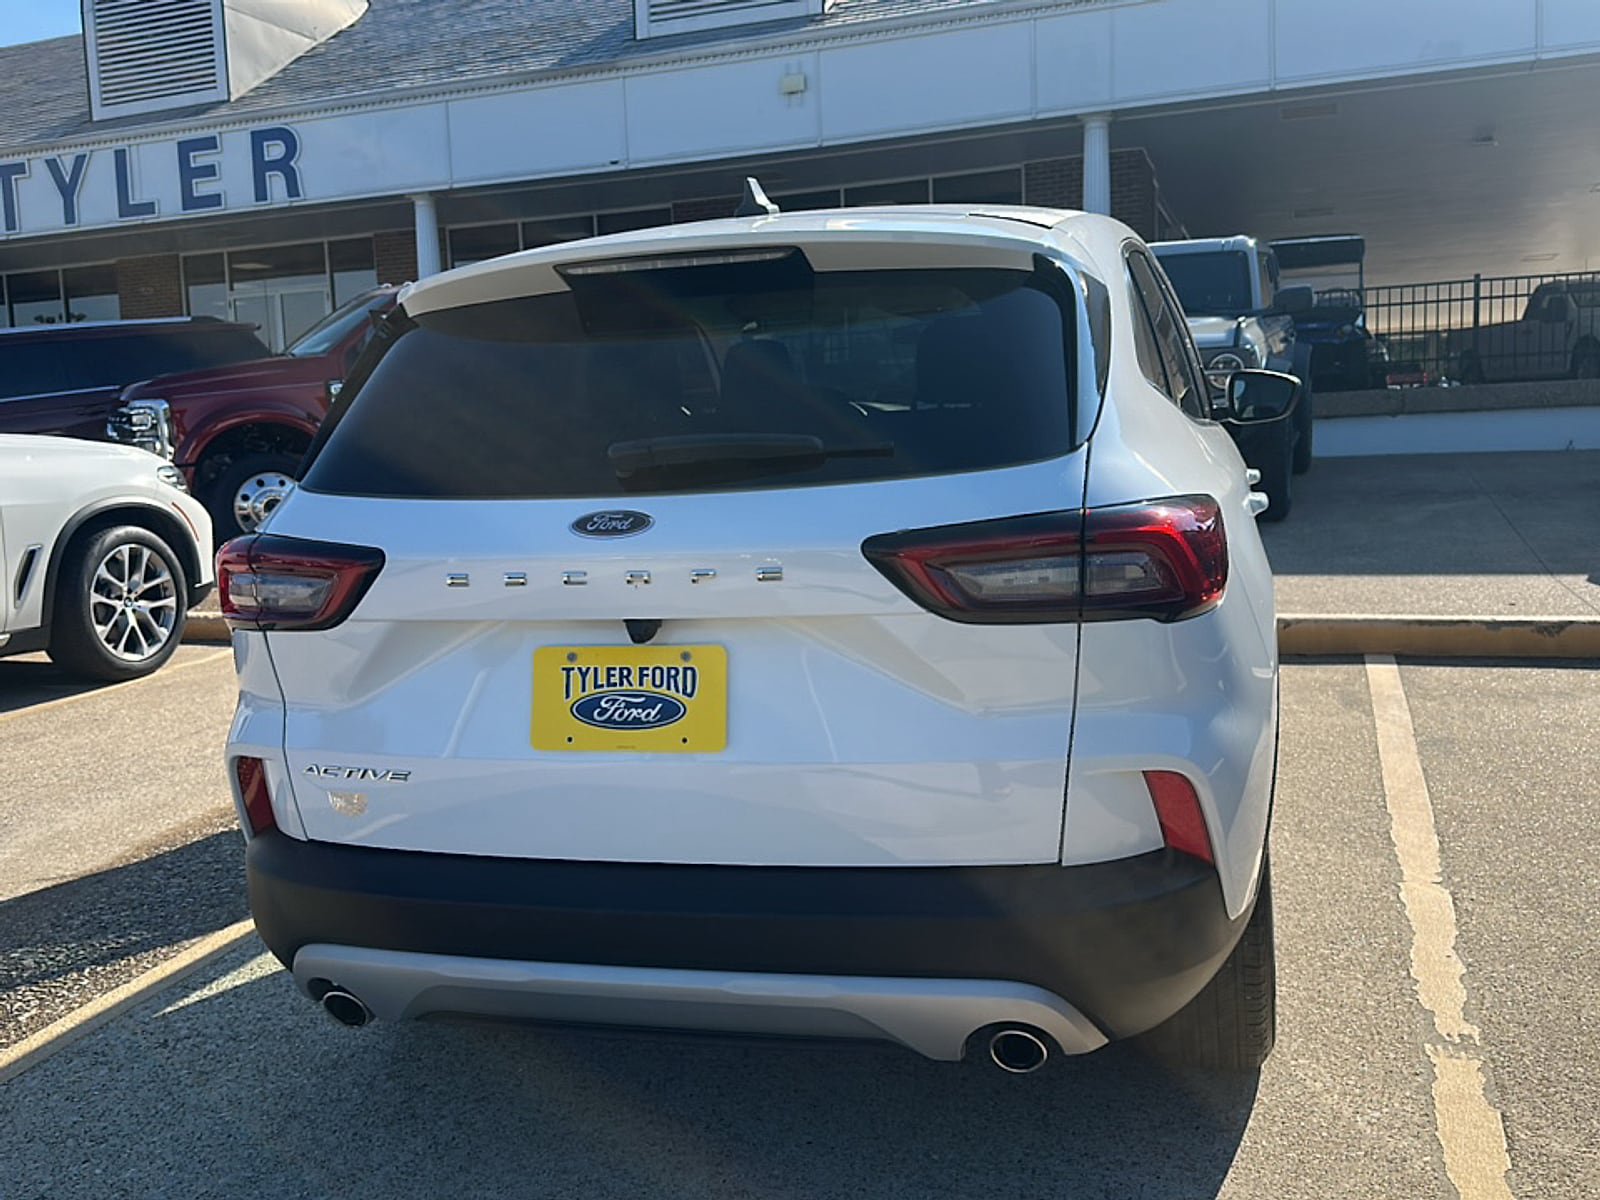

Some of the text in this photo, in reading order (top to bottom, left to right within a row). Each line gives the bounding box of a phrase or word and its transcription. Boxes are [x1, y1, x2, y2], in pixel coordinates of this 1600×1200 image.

[0, 125, 302, 232] TYLER
[586, 513, 634, 530] Ford
[446, 567, 783, 587] ESCAPE
[560, 666, 698, 700] TYLER FORD
[593, 695, 663, 722] Ford
[303, 763, 411, 782] ACTIVE
